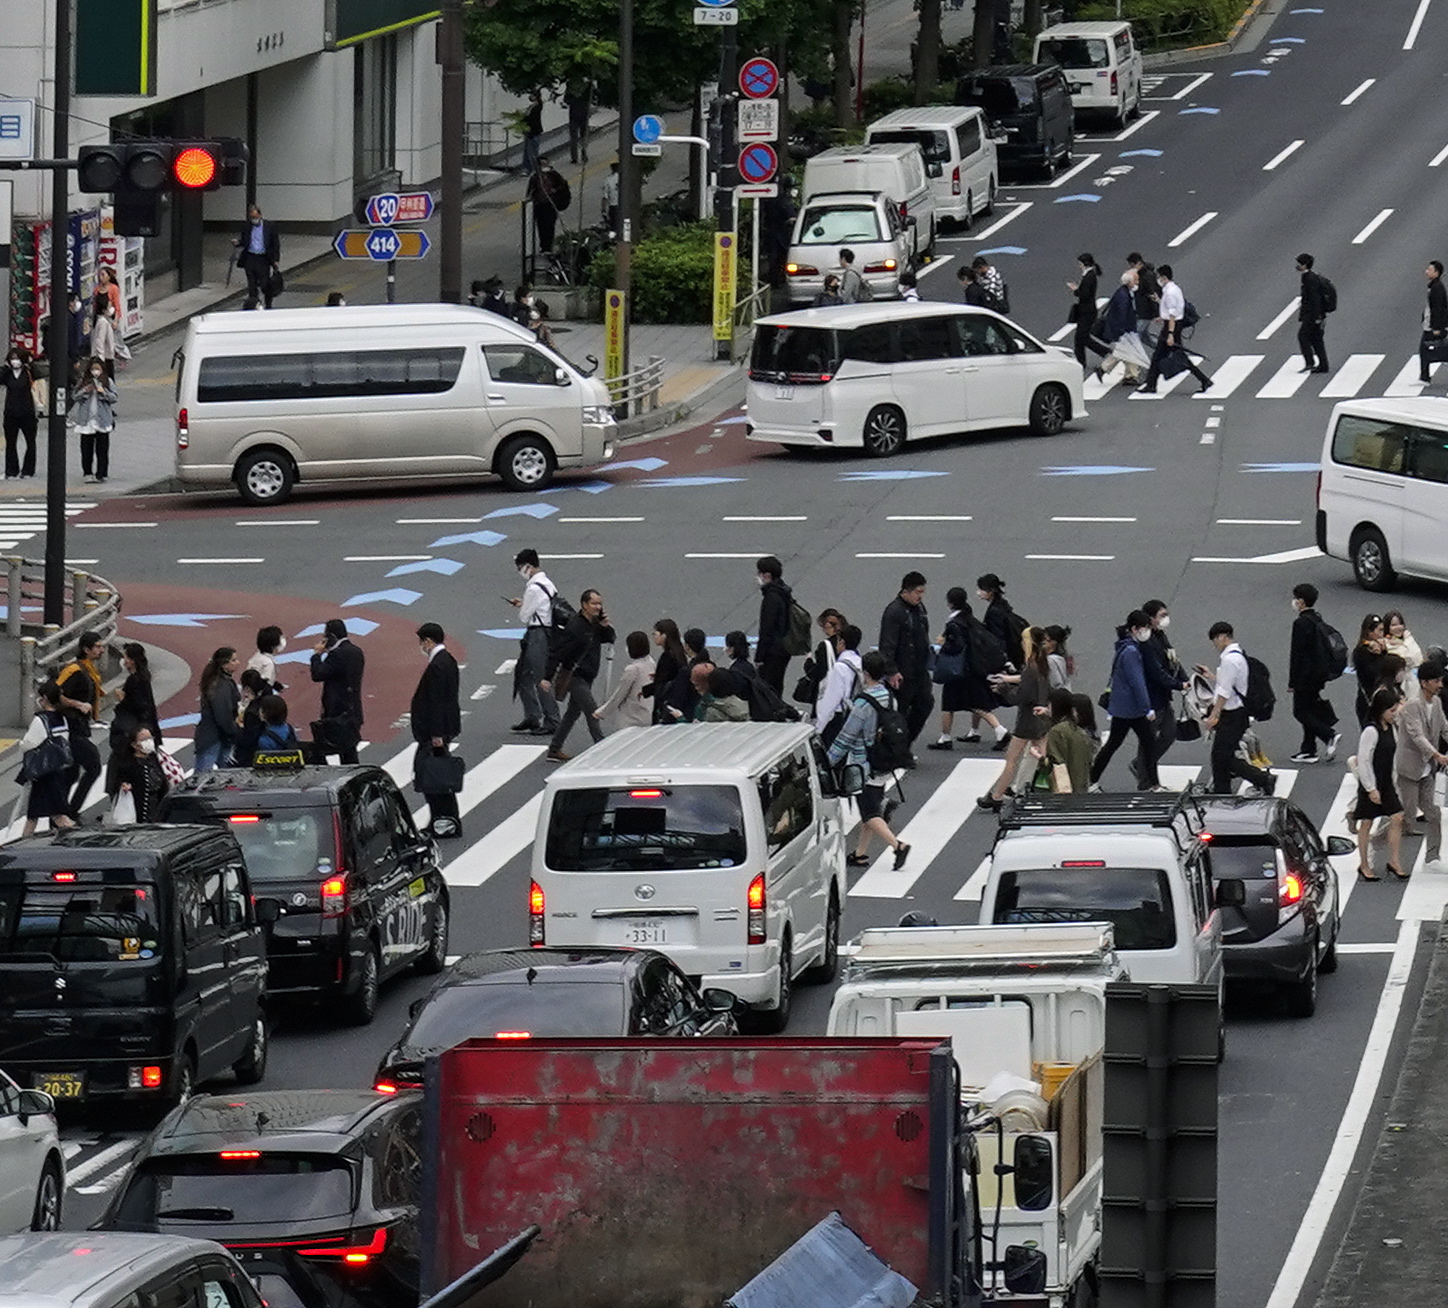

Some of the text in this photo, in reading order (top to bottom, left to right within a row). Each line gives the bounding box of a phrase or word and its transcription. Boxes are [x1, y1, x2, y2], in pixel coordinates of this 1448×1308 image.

[701, 10, 732, 22] 7-20
[381, 197, 397, 218] 20
[369, 236, 397, 253] 414
